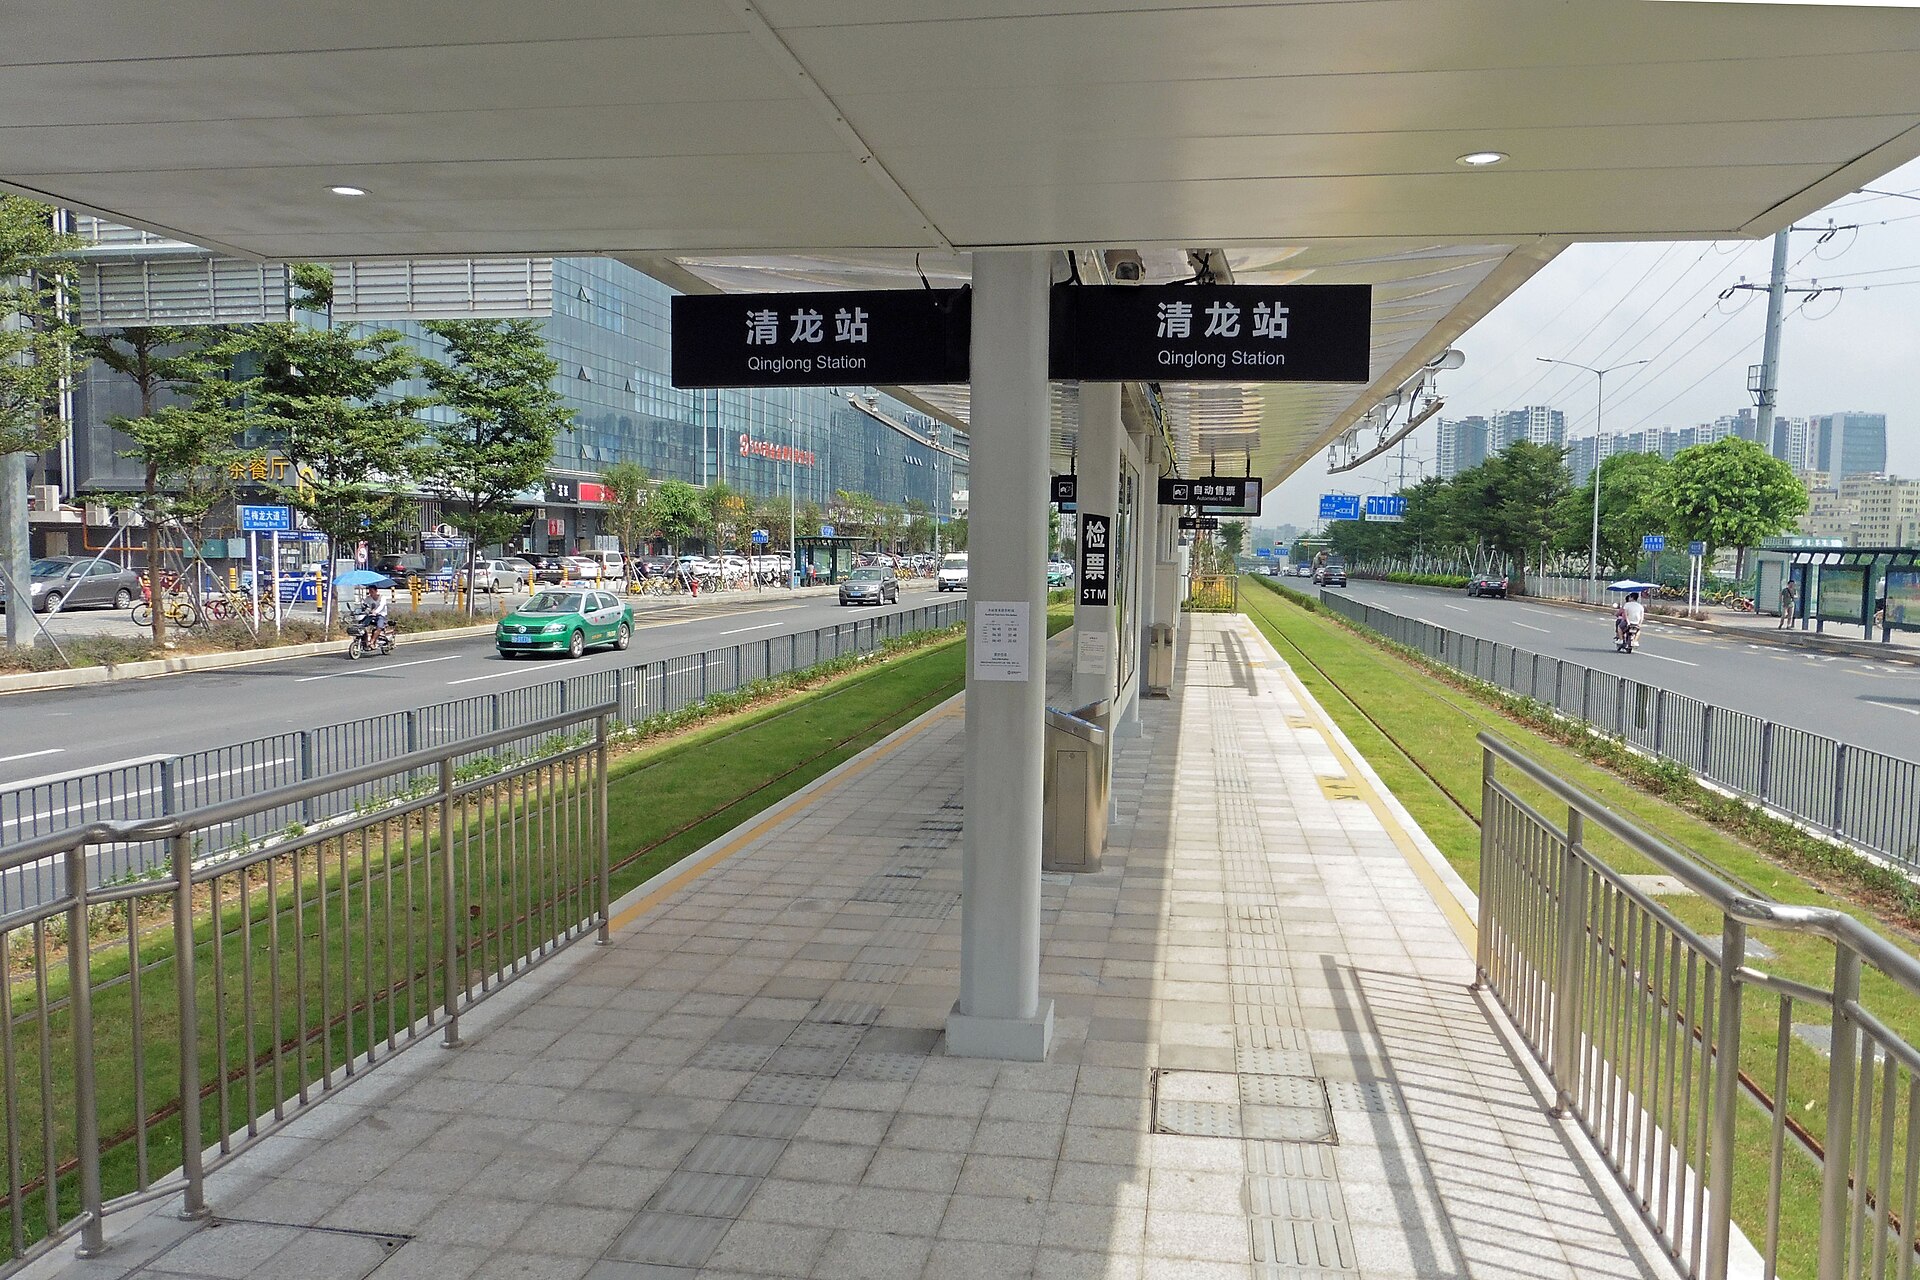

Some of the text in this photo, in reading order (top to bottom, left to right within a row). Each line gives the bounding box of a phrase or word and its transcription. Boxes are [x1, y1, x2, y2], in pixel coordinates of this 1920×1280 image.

[746, 307, 869, 344] 清龙站
[1157, 301, 1289, 339] 清龙站
[747, 355, 866, 374] Qinglong Station
[1158, 350, 1285, 369] Qinglong Station
[1193, 485, 1236, 496] 自动售票
[251, 510, 280, 521] 梅龙大道
[1085, 520, 1106, 580] 检票
[1083, 589, 1106, 600] STM
